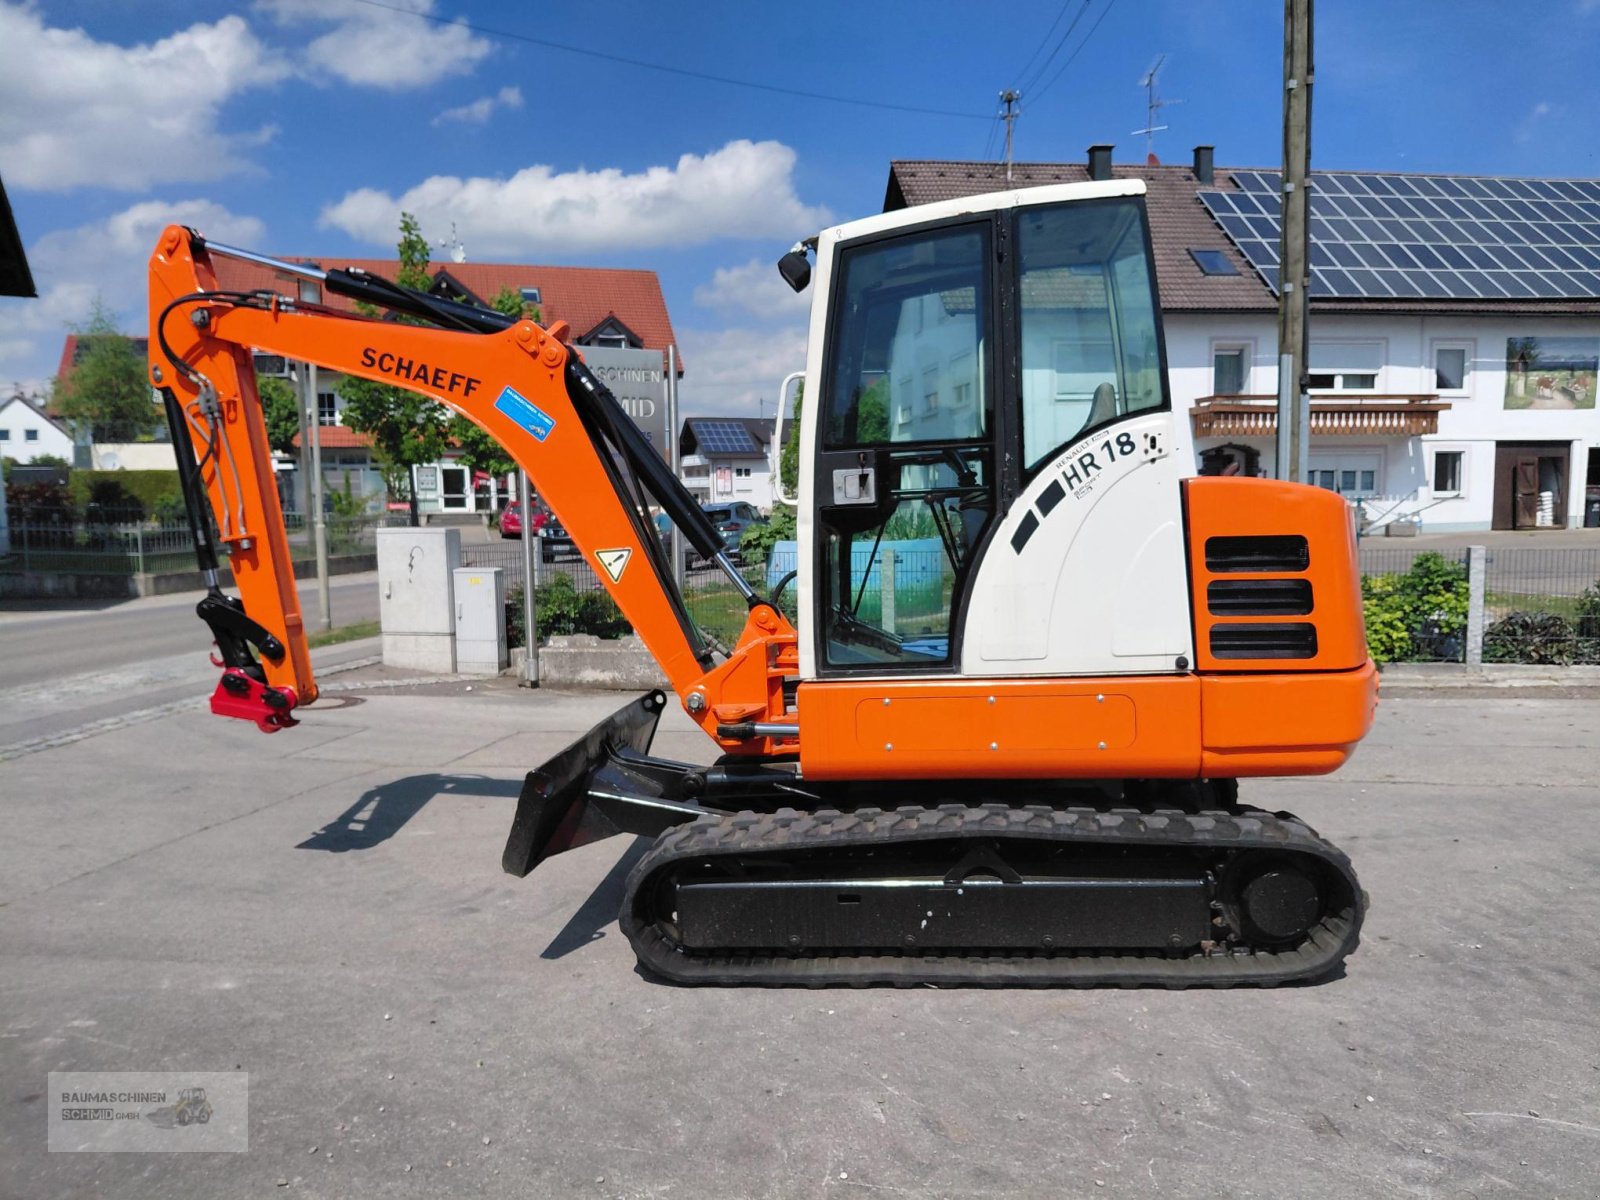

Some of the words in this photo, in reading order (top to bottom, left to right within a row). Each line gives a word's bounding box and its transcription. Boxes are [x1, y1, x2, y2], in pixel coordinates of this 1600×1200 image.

[361, 347, 481, 397] SCHAEFF
[590, 366, 660, 383] SCHINEN
[1055, 440, 1091, 469] RENAULT
[1061, 452, 1103, 491] HR
[1100, 432, 1136, 463] 18
